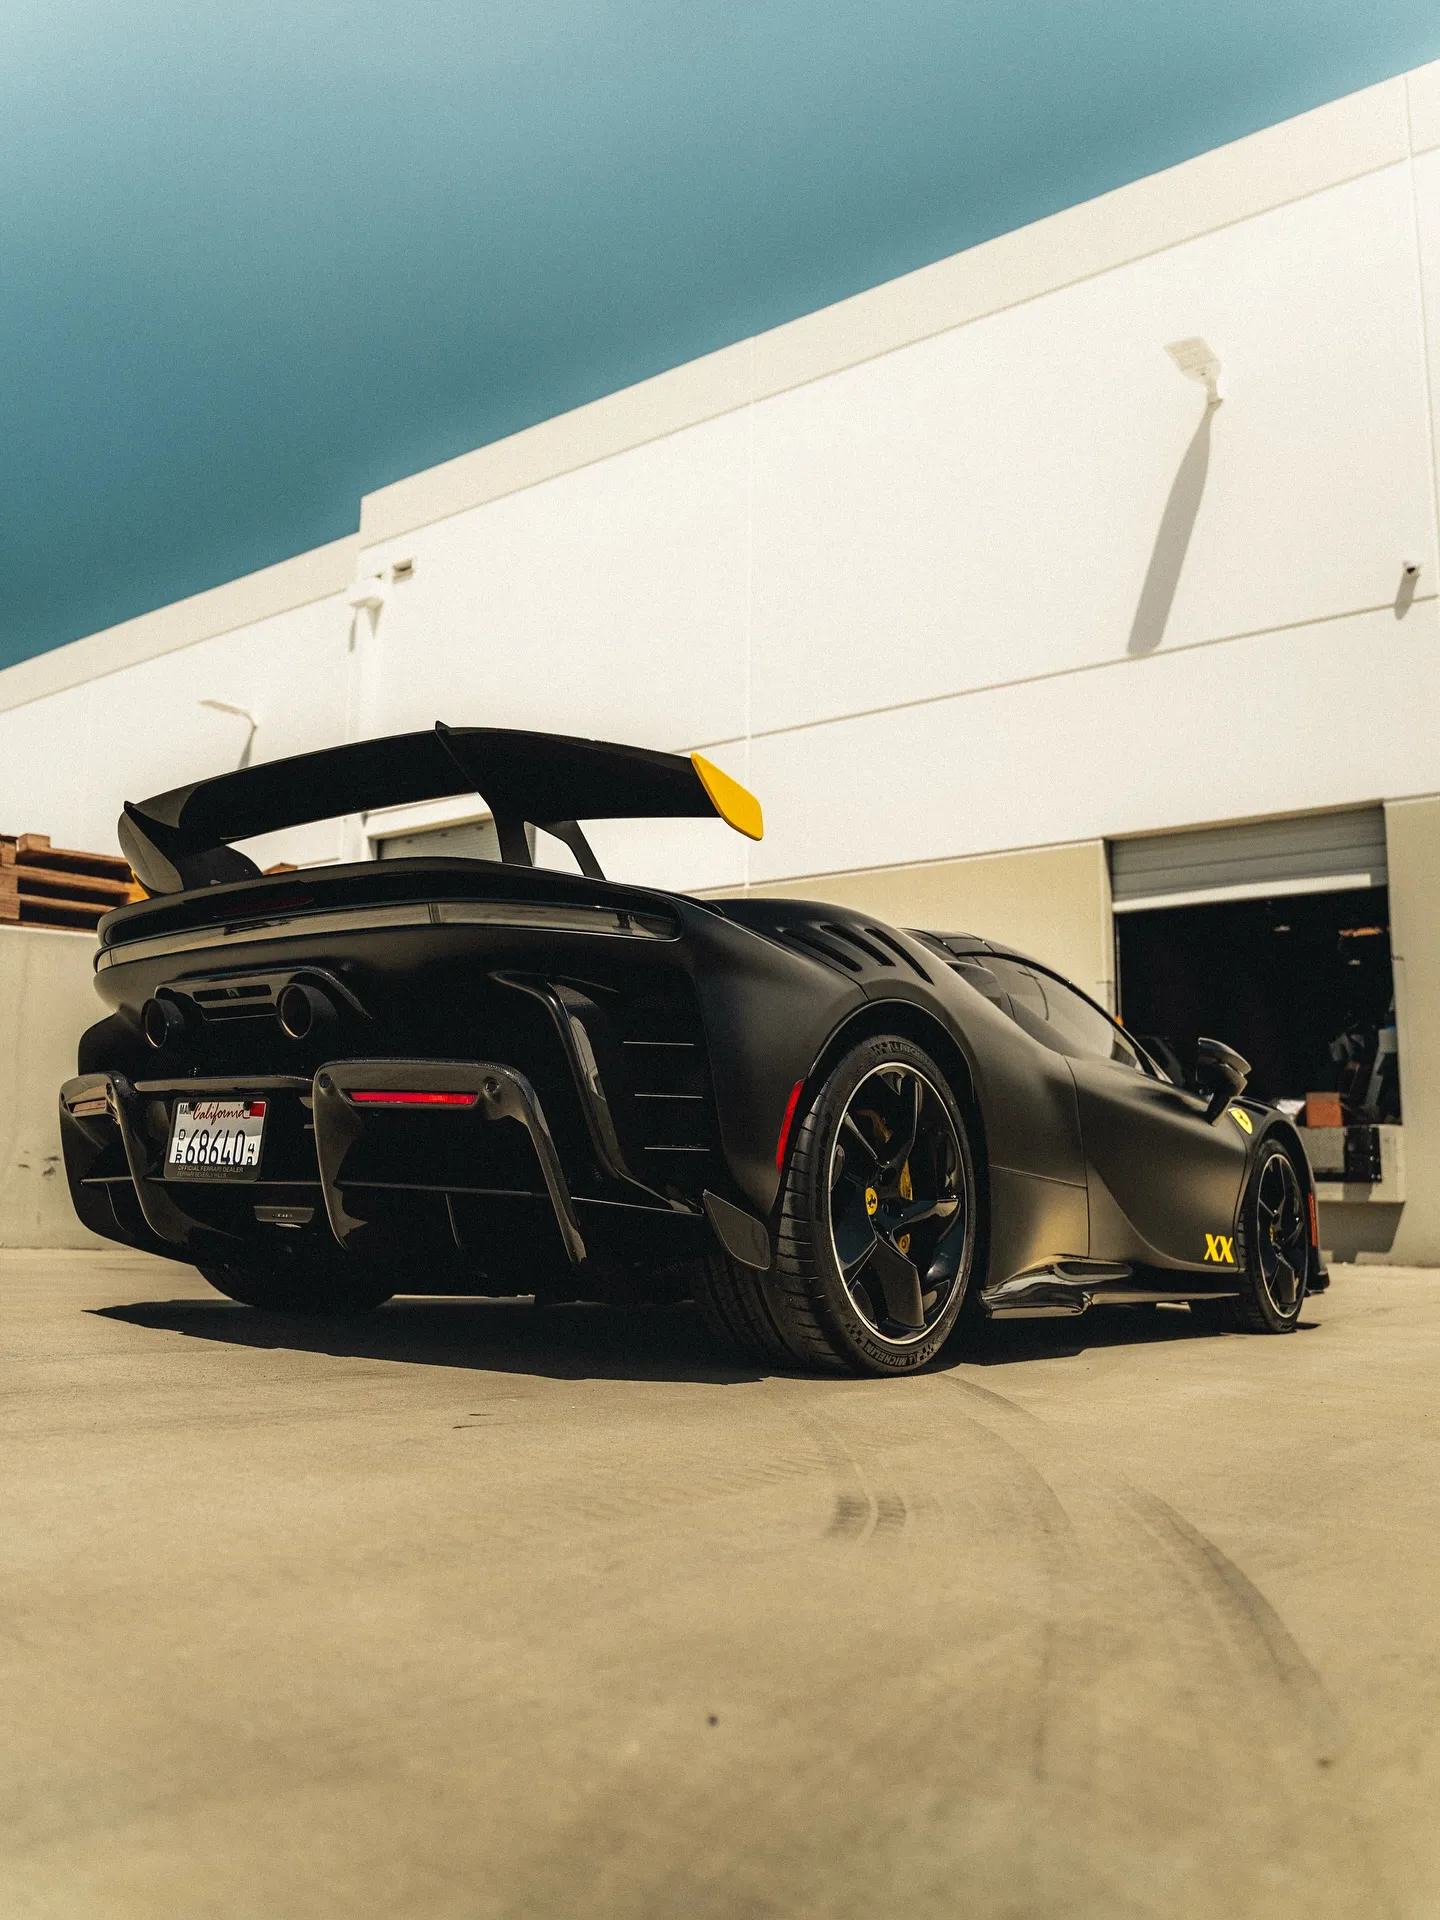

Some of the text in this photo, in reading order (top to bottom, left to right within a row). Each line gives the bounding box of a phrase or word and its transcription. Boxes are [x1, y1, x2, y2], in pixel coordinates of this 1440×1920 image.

[193, 1103, 250, 1126] California
[186, 1129, 245, 1165] 68640
[1204, 1233, 1234, 1263] XX
[864, 1343, 907, 1366] MICHELIN
